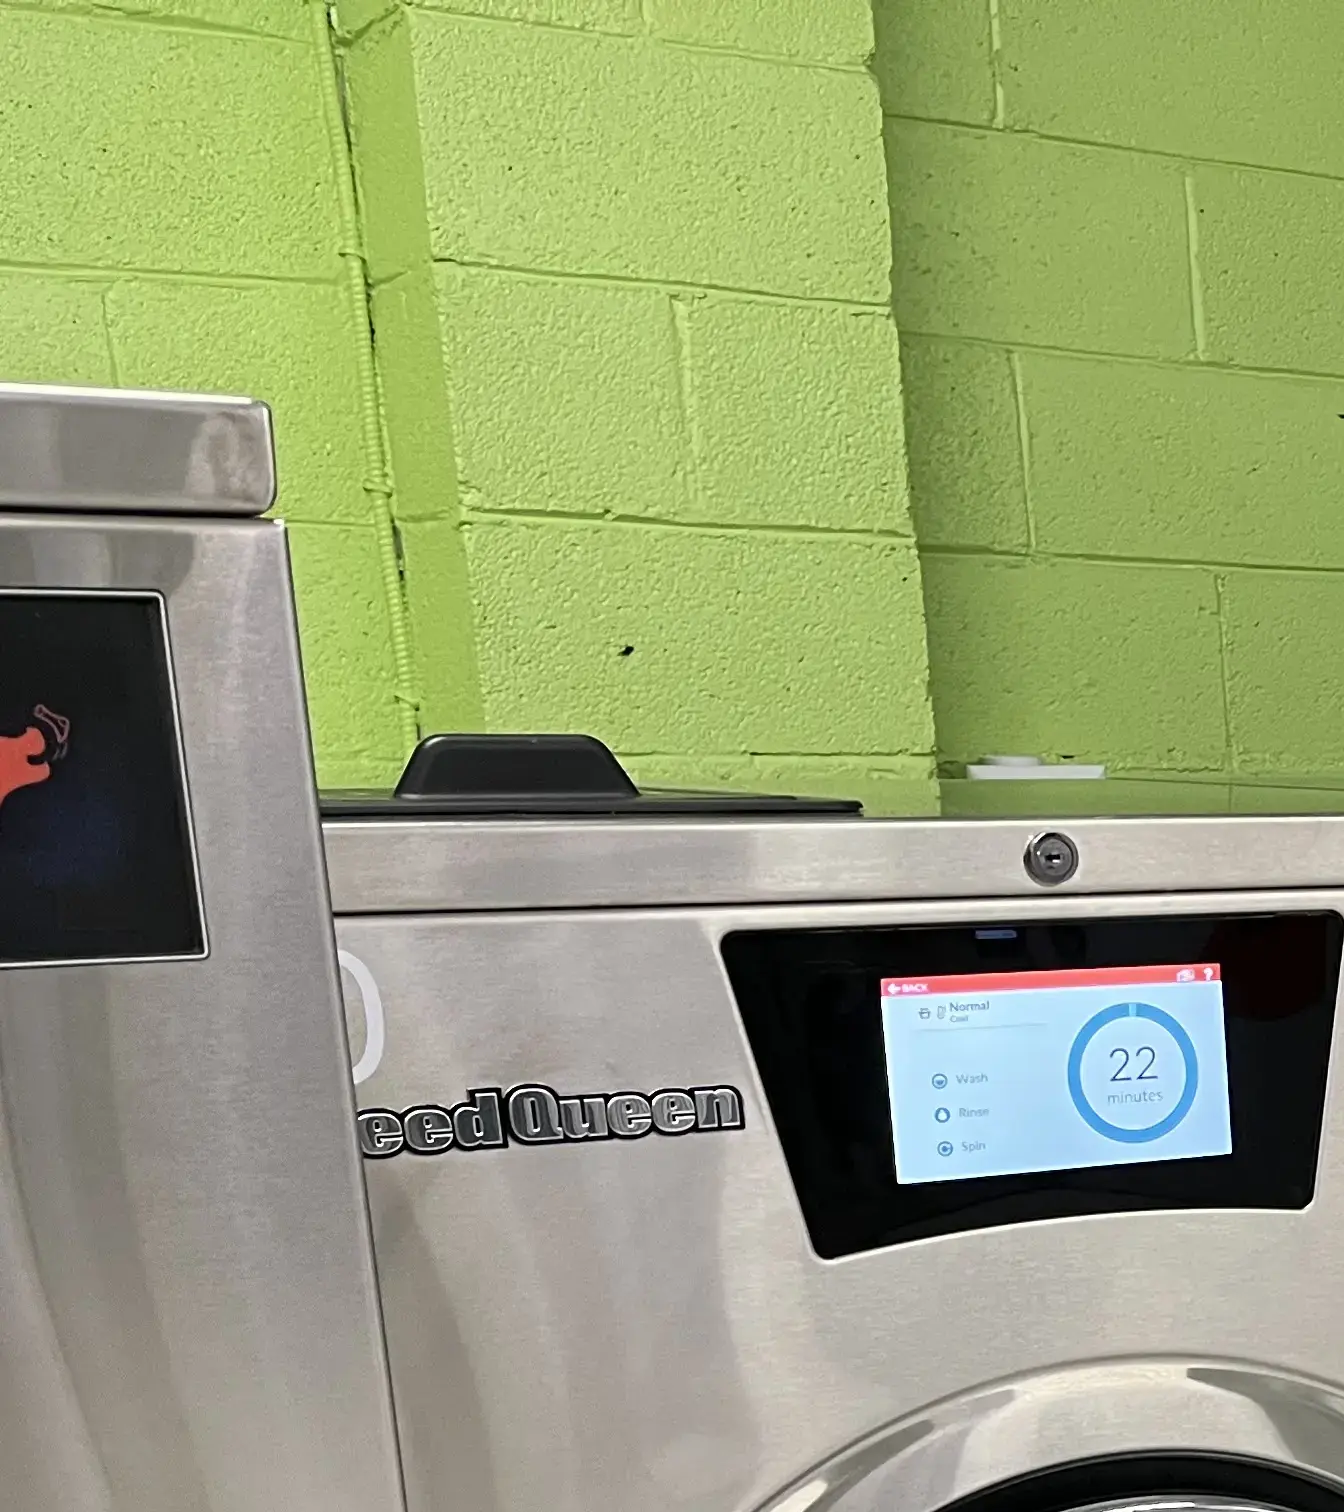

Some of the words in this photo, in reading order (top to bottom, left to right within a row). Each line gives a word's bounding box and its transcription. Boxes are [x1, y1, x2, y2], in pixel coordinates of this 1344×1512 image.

[901, 983, 929, 993] BACK
[949, 1000, 990, 1012] Normal
[1109, 1046, 1159, 1083] 22
[956, 1072, 989, 1085] Wash
[1107, 1088, 1164, 1105] minutes
[503, 1083, 746, 1147] Queen
[958, 1106, 990, 1119] Rinse
[961, 1141, 987, 1153] Spin
